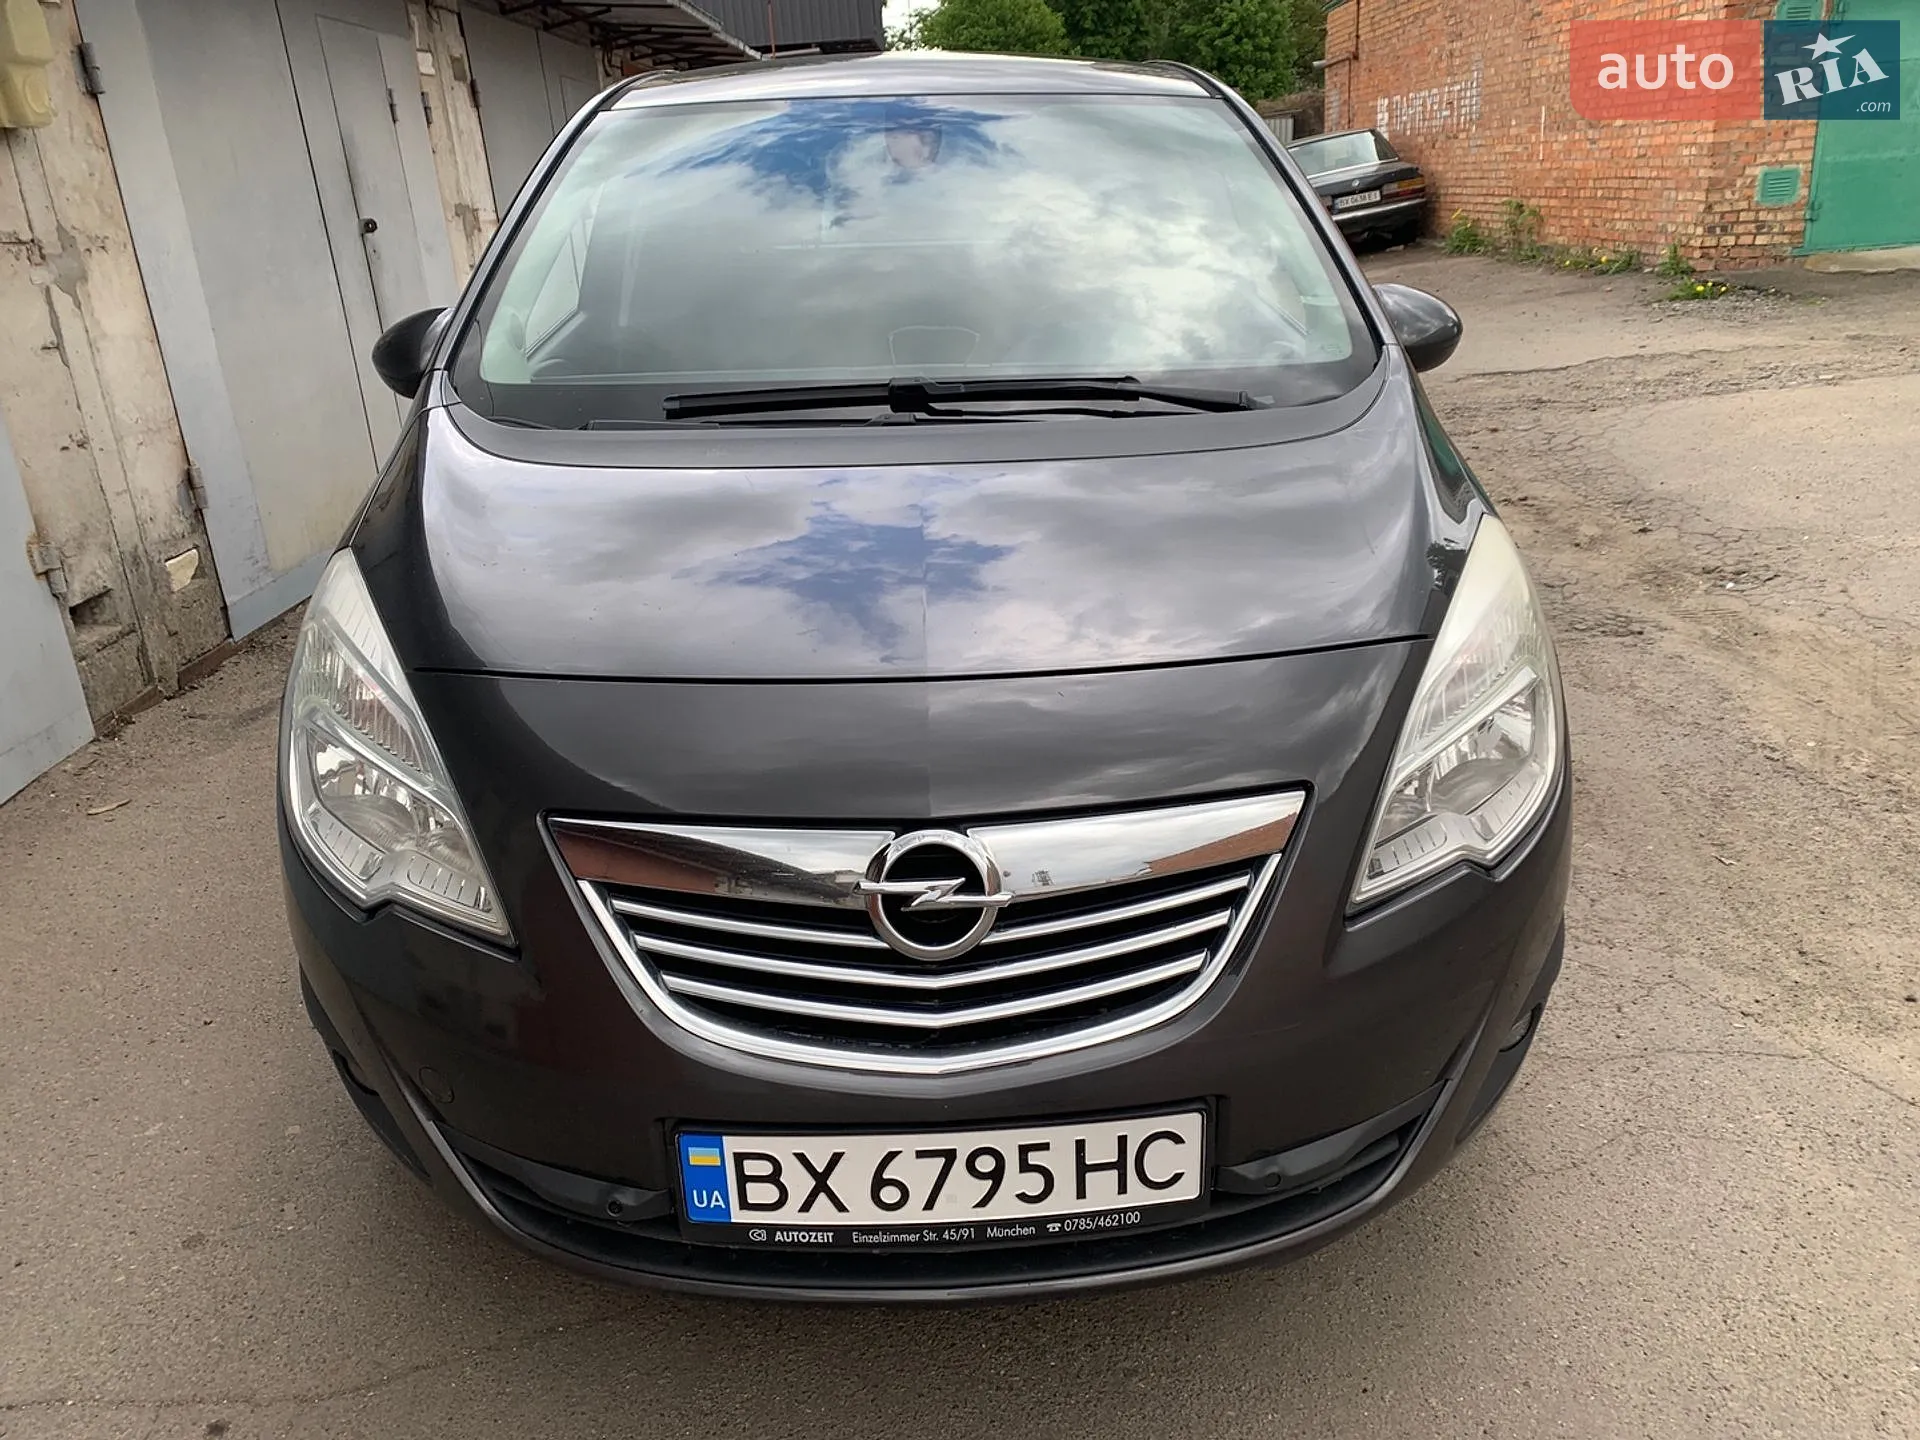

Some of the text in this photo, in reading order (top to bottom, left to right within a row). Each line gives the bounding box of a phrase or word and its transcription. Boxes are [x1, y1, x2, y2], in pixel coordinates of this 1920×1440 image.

[732, 1130, 1187, 1213] BX 6795 HC
[693, 1189, 726, 1209] UA
[774, 1211, 1141, 1244] AUTOZEIT Einzelzimmer Str. 45/91 München 0785/462100
